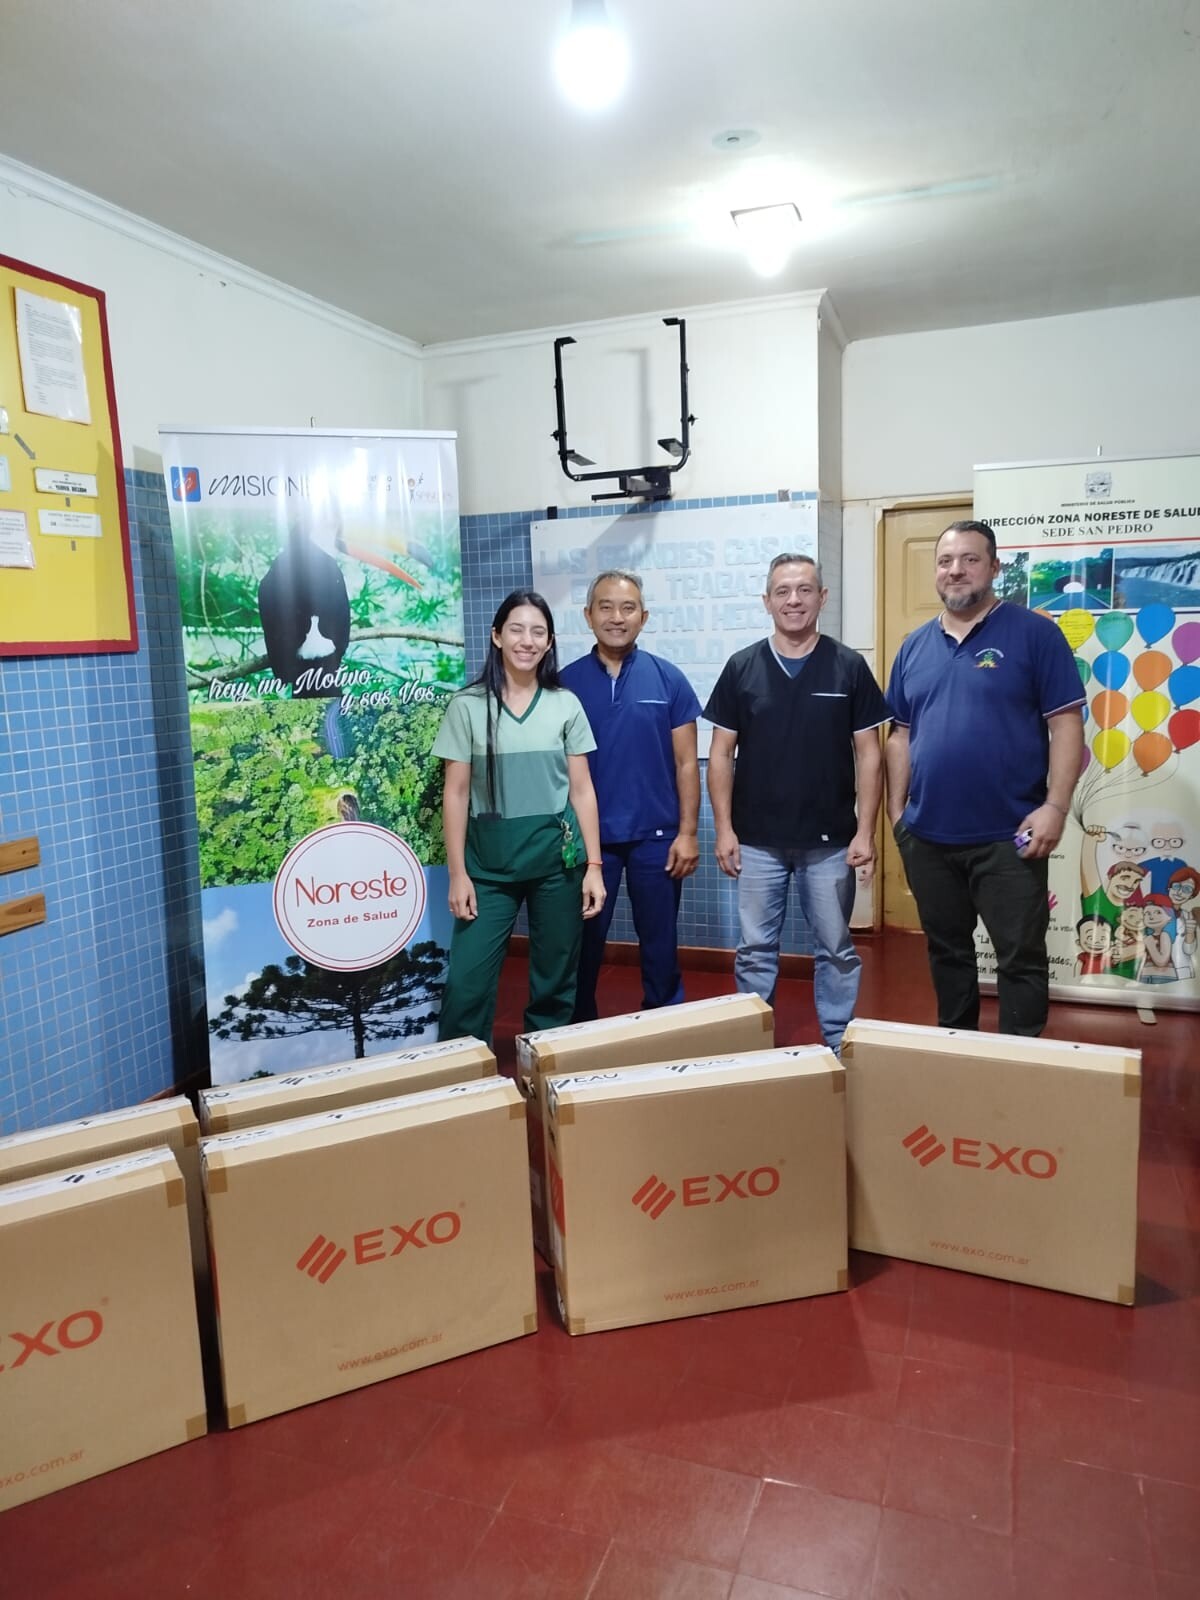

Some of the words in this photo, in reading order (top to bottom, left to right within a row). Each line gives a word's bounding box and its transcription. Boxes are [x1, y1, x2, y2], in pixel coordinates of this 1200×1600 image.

[981, 513, 1044, 528] DIRECCIÓN
[1048, 513, 1081, 524] ZONA
[1084, 510, 1141, 522] NORESTE
[1144, 509, 1161, 519] DE
[1042, 527, 1075, 538] SEDE
[1078, 525, 1103, 536] SAN
[1107, 523, 1153, 535] PEDRO
[208, 678, 250, 703] hay
[257, 677, 288, 696] un
[341, 693, 354, 715] y
[295, 870, 407, 907] Noreste
[307, 917, 339, 928] Zona
[343, 913, 359, 924] de
[363, 909, 398, 922] Salud
[952, 1136, 1058, 1180] EXO
[682, 1166, 780, 1207] EXO
[353, 1211, 462, 1265] EXO
[929, 1239, 1032, 1266] www.exo.com.ar
[663, 1279, 760, 1302] www.exo.com.ar
[0, 1309, 104, 1373] XO
[337, 1332, 443, 1372] www.exo.com.ar
